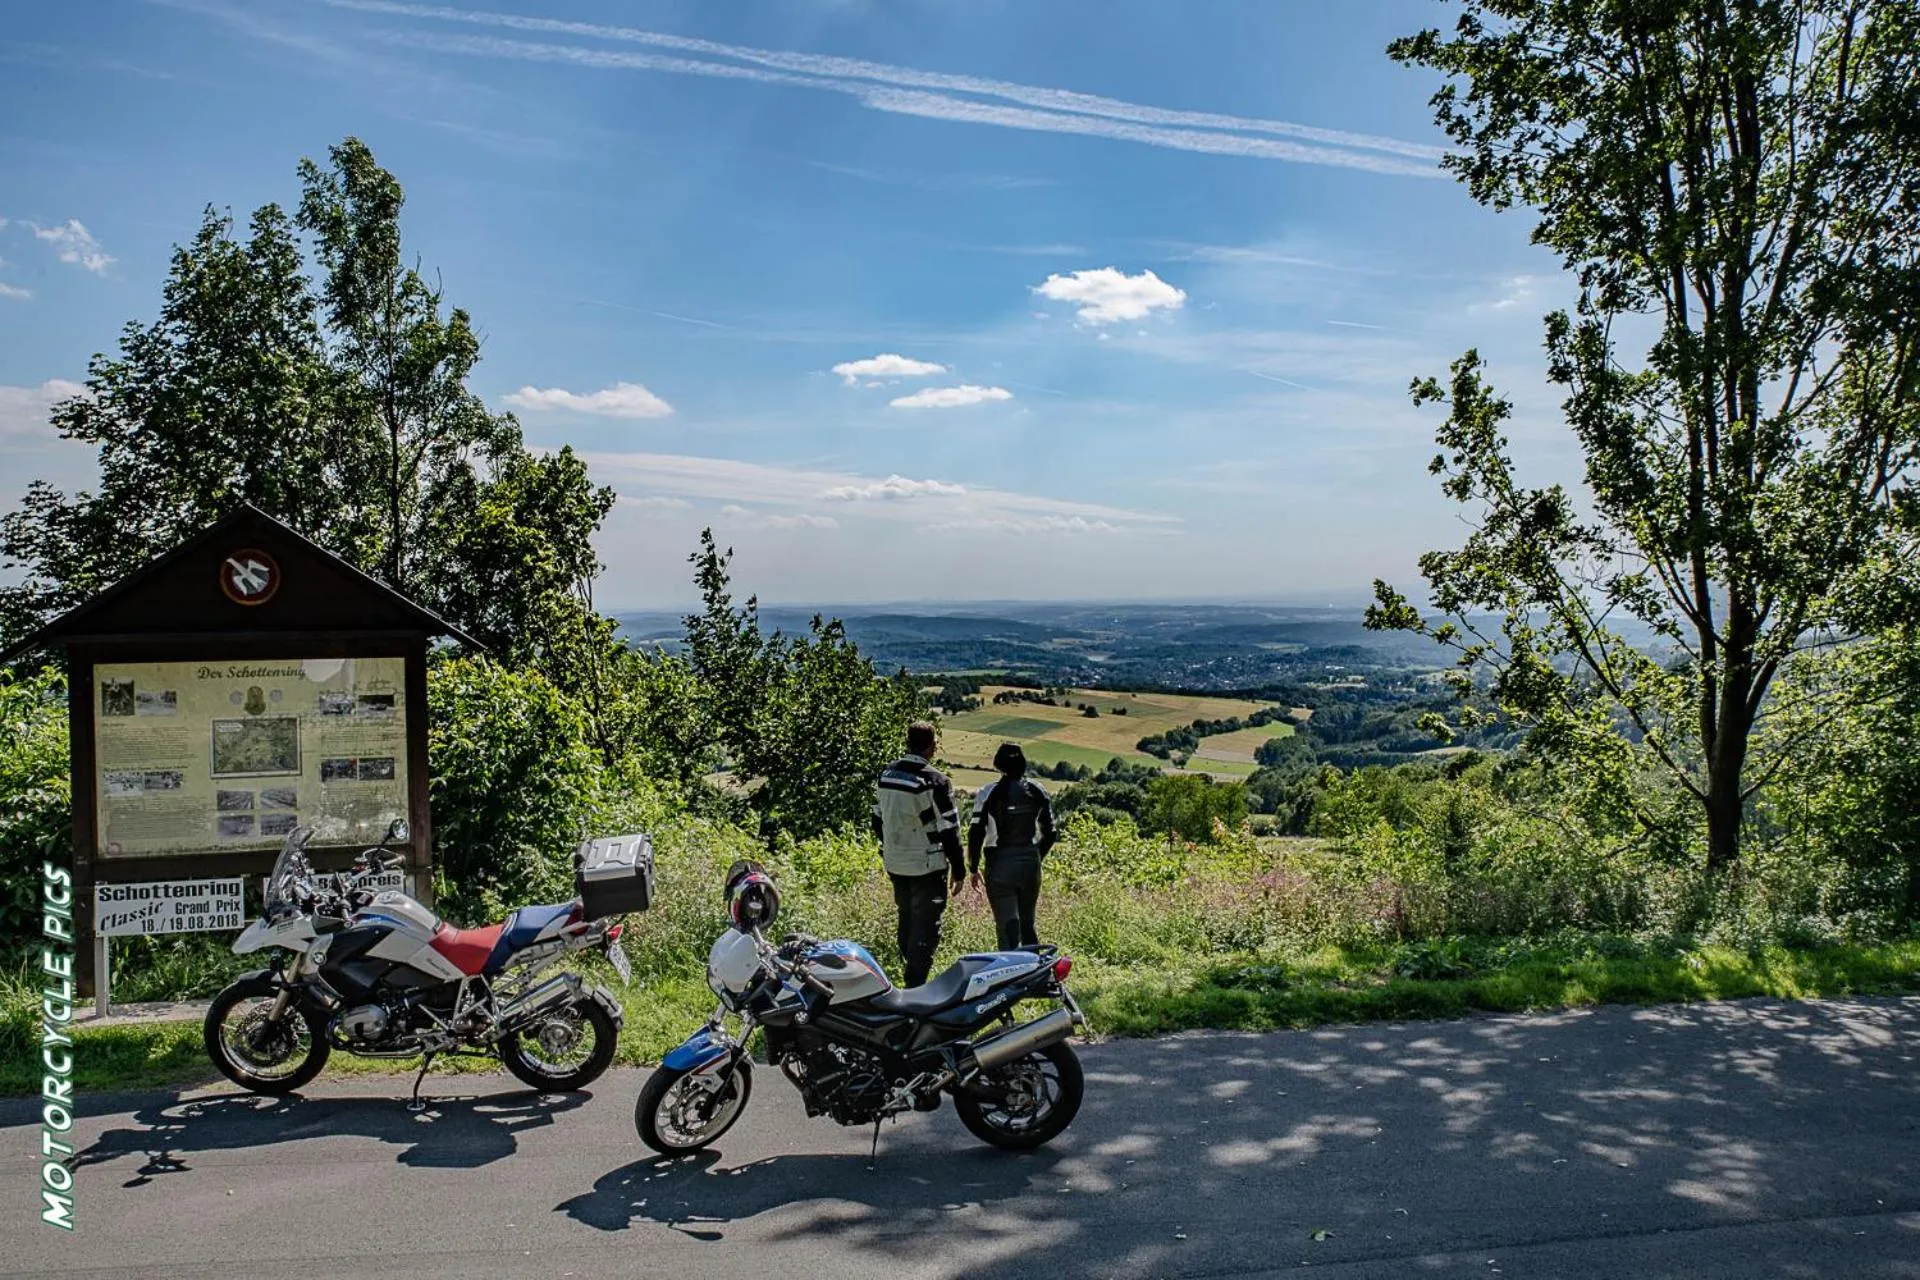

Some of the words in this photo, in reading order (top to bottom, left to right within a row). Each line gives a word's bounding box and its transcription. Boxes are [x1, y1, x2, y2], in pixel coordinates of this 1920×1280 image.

[198, 666, 223, 679] Der
[227, 665, 306, 680] Schottenring
[99, 881, 241, 902] Schottenring
[100, 901, 164, 932] Classic
[175, 901, 210, 915] Grand
[216, 899, 241, 913] Prix
